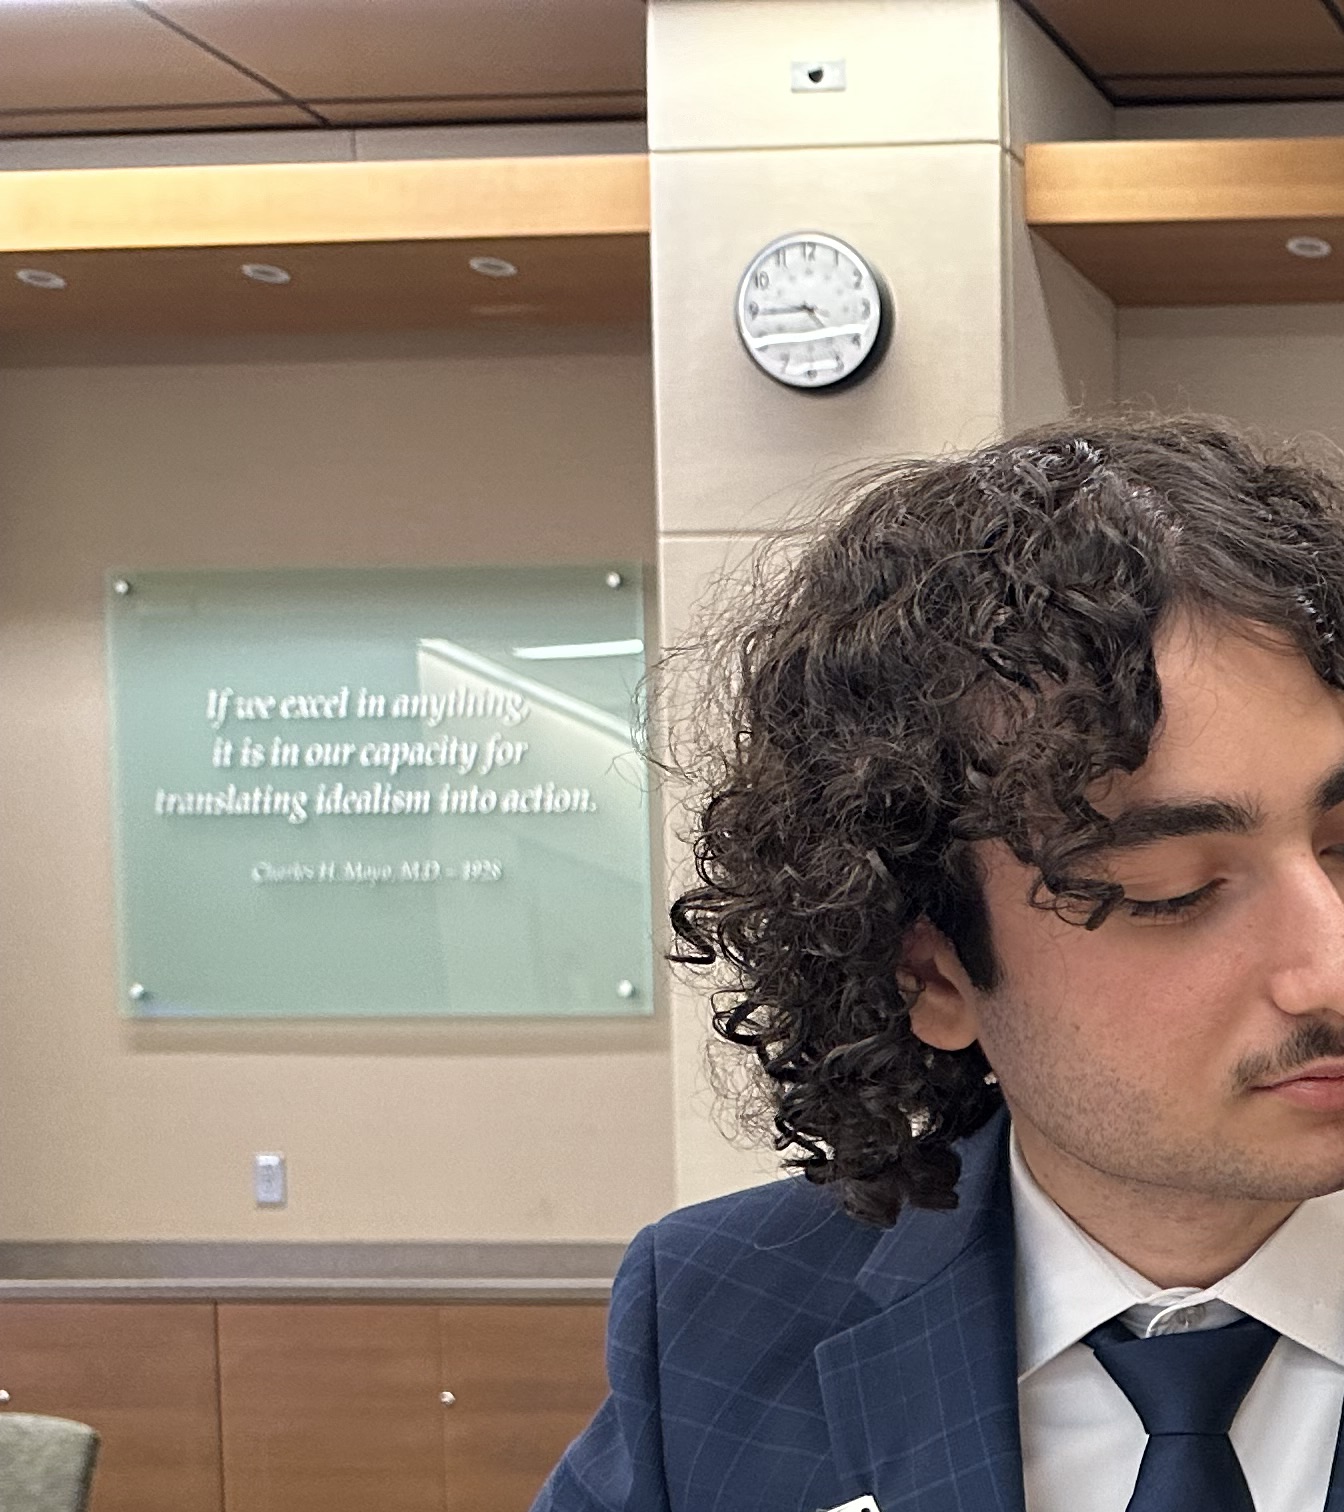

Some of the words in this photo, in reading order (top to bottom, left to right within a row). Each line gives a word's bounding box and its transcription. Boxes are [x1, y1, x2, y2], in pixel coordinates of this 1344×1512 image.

[753, 271, 770, 290] 10
[206, 686, 234, 730] If
[236, 695, 277, 720] we
[279, 685, 350, 720] excel
[357, 686, 386, 719] in
[212, 735, 233, 768] it
[240, 735, 266, 768] is
[271, 735, 300, 767] in
[305, 742, 356, 767] our
[360, 734, 478, 776] capacity
[477, 731, 529, 776] for
[155, 782, 308, 825] translating
[315, 781, 431, 815] idealism
[439, 782, 498, 815] into
